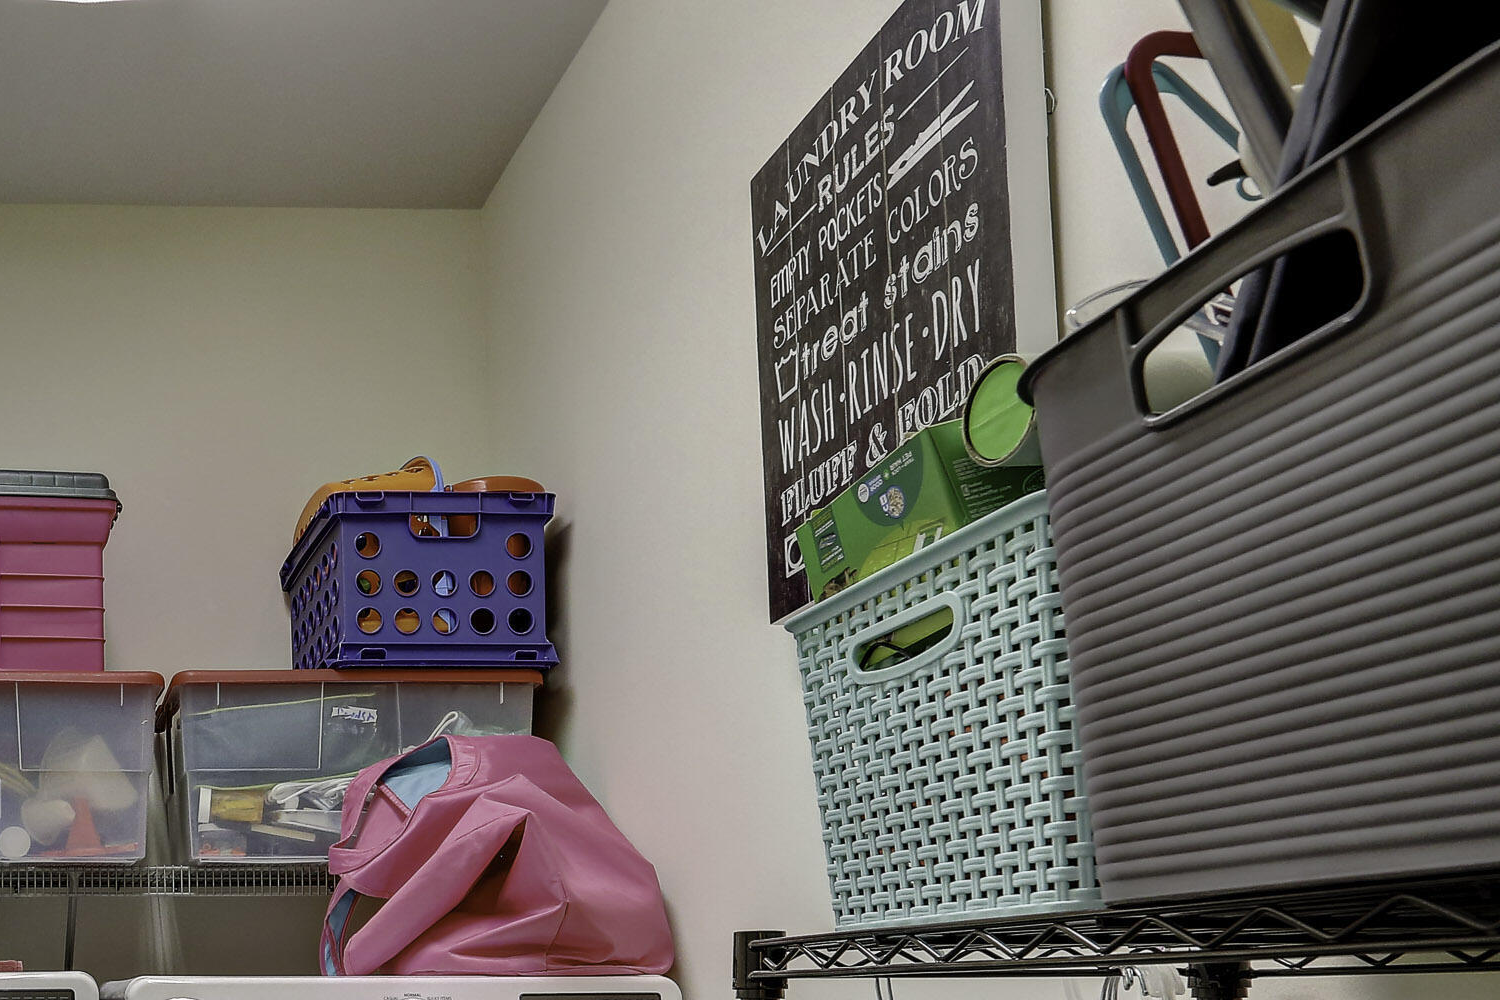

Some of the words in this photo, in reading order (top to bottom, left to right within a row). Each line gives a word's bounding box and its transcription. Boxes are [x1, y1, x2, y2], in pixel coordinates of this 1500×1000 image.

[756, 70, 878, 257] LAUNDRY
[883, 0, 986, 93] ROOM
[818, 103, 895, 213] RULES
[770, 240, 810, 308] EMPTY
[818, 172, 883, 261] POCKETS
[773, 229, 877, 349] SEPARATE
[887, 137, 979, 244] COLORS
[800, 290, 869, 380] treat
[884, 202, 979, 309] stains
[778, 378, 836, 474] WASH
[848, 312, 917, 425] RINSE
[932, 258, 980, 361] DRY
[780, 440, 858, 527] FLUFF
[865, 422, 888, 469] &
